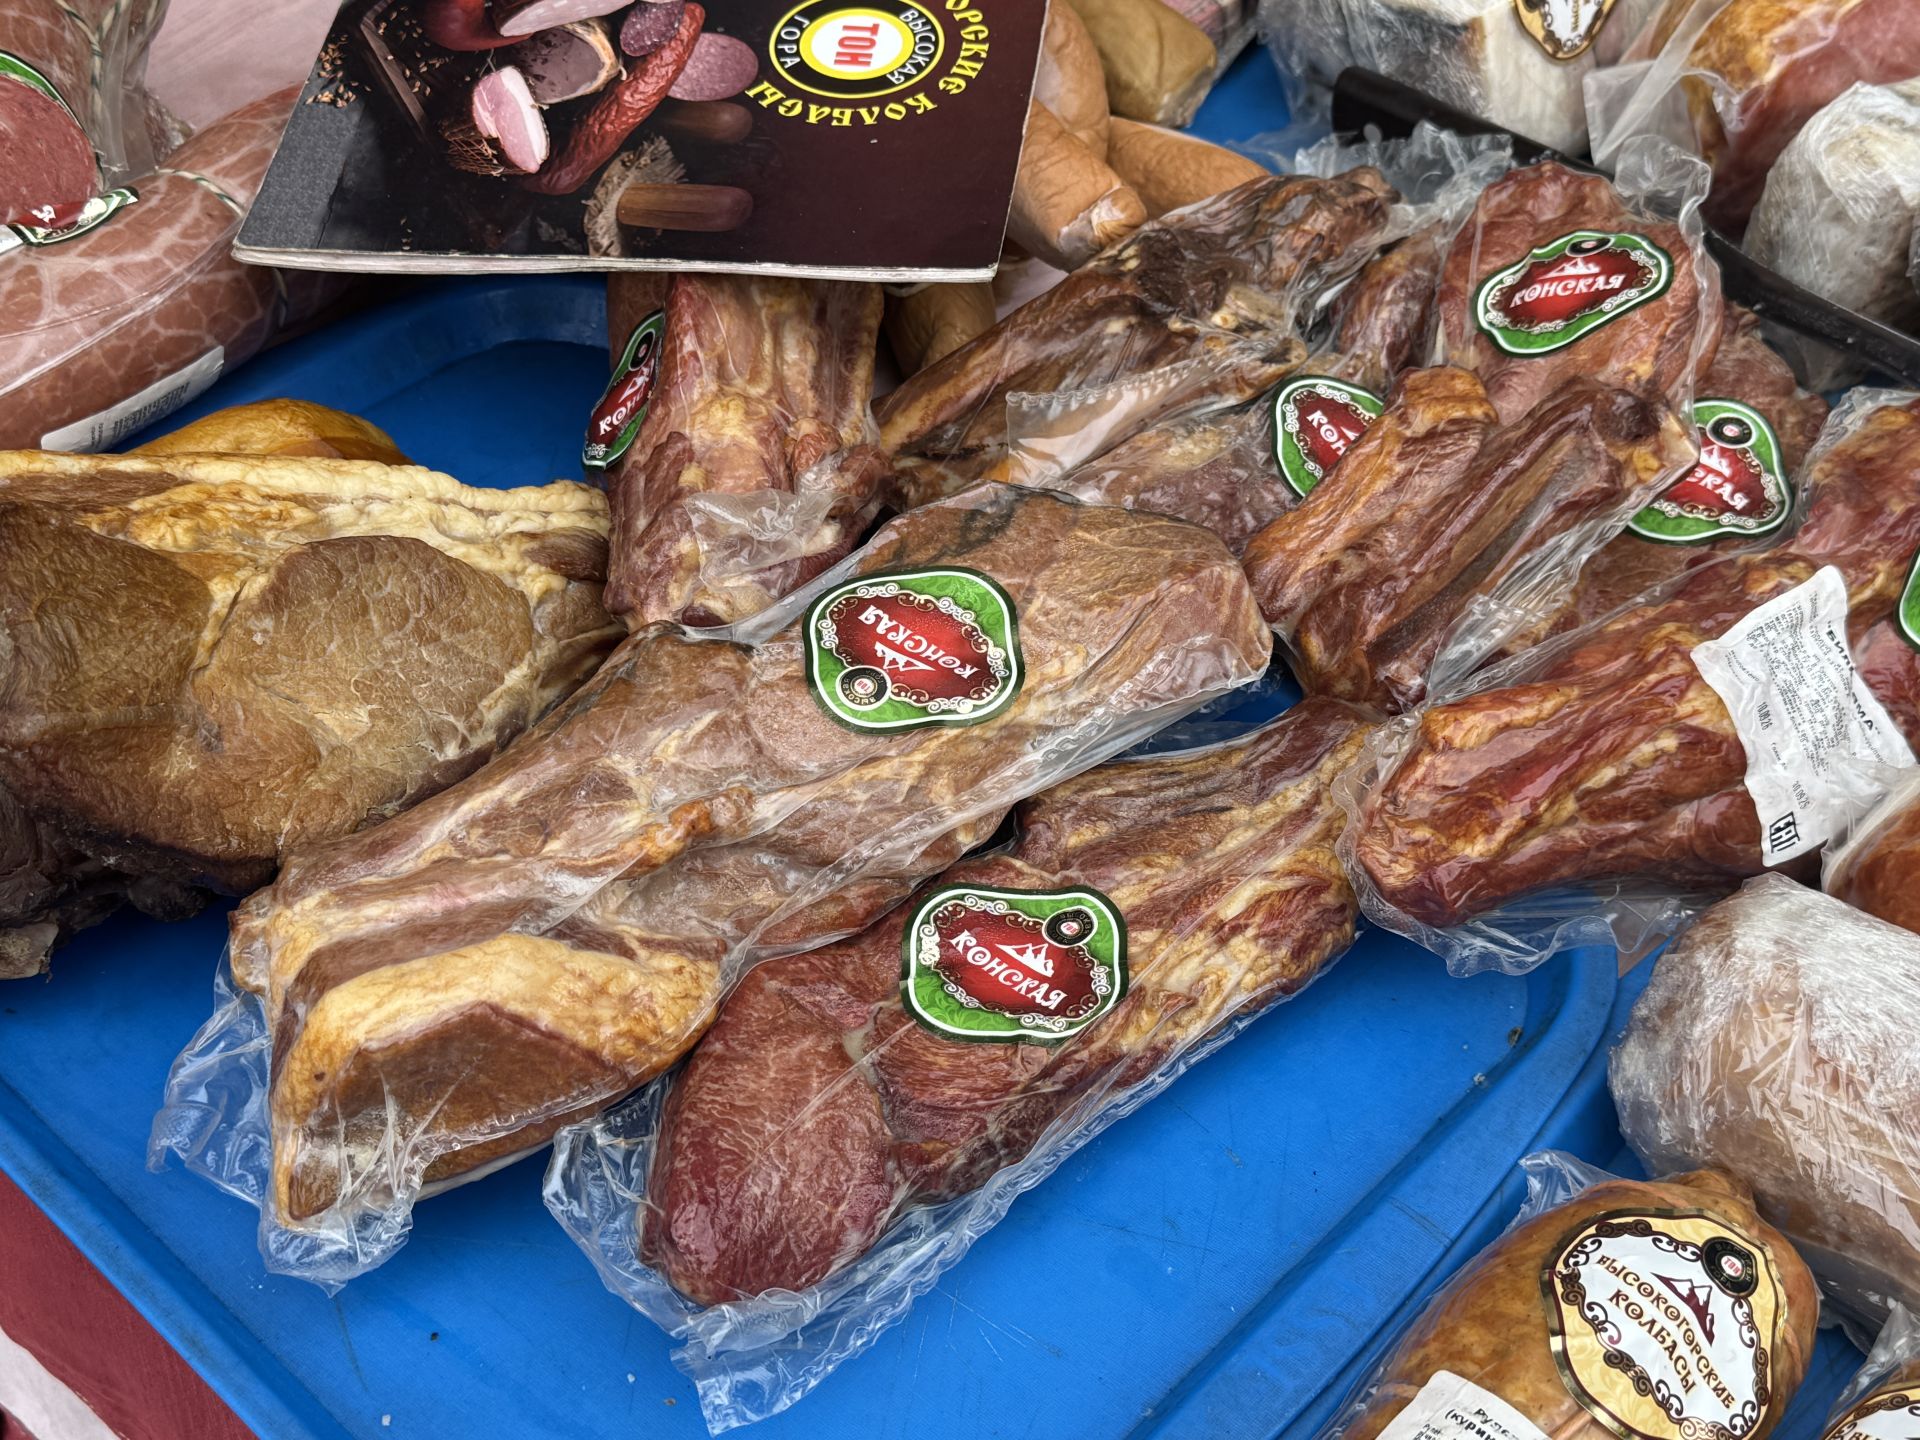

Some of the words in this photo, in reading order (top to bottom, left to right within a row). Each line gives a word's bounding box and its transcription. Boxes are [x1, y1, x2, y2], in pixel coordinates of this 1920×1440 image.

[777, 14, 810, 69] ГОРА
[833, 22, 880, 67] ТОН
[886, 8, 936, 85] ВЫСОКАЯ
[744, 80, 938, 127] КОЛБАСЫ
[1509, 274, 1626, 309] КОНСКАЯ
[858, 604, 981, 680] КОНСКАЯ
[842, 677, 877, 705] ВЫСОКАЯ
[950, 929, 1068, 1011] КОНСКАЯ
[1596, 1255, 1736, 1409] ВЫСОКОГОРСКИЕ
[1608, 1288, 1697, 1395] КОЛБАСЫ
